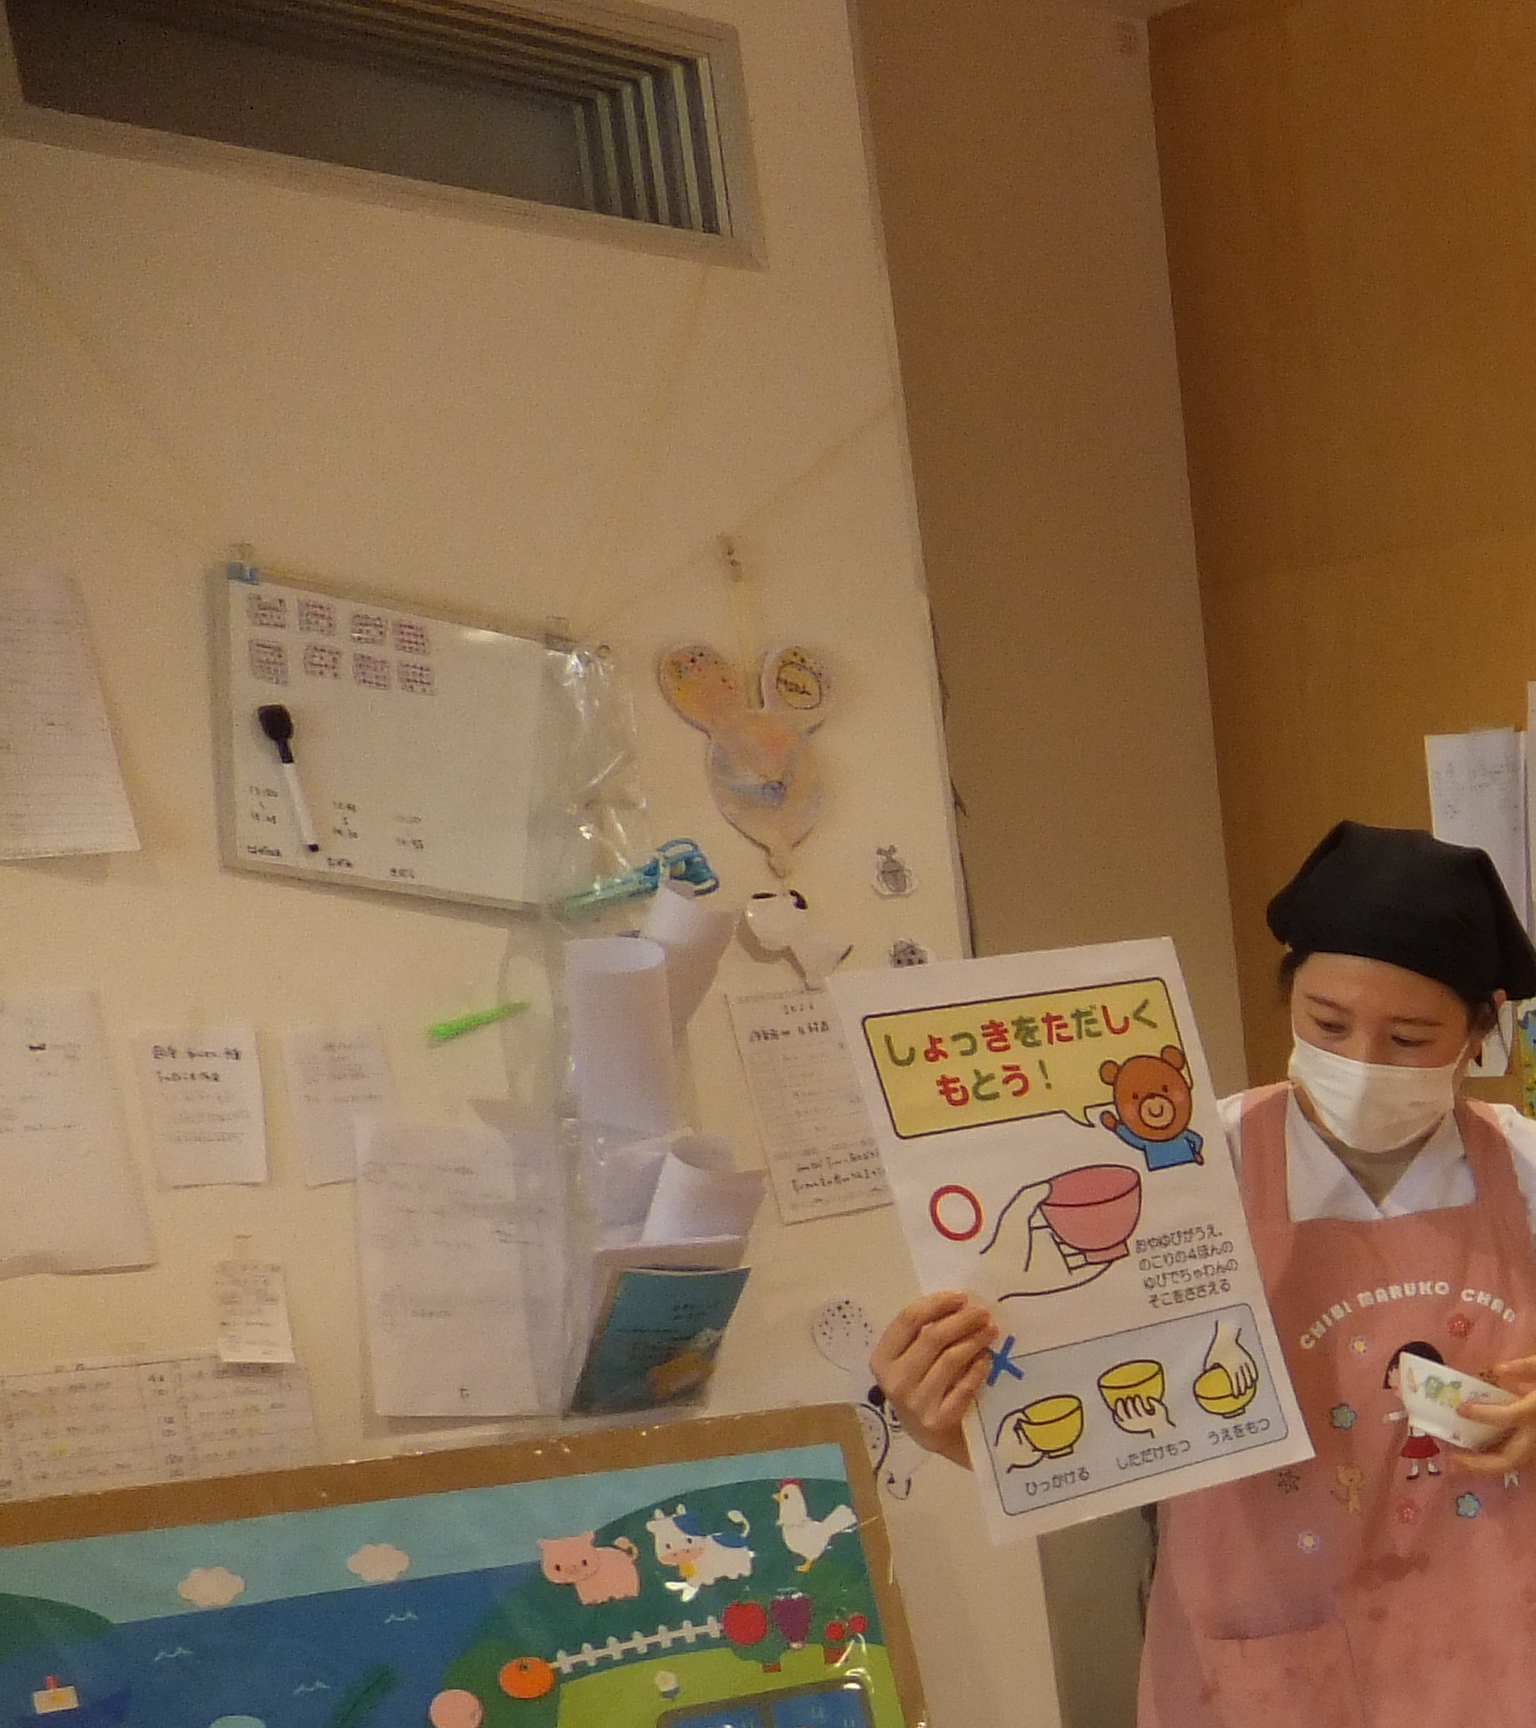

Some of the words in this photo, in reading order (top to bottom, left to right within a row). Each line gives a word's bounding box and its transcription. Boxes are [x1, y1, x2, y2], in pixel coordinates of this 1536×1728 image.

[884, 999, 1158, 1067] しょっきをただしく
[1357, 1281, 1451, 1308] MARUKO
[1207, 1417, 1271, 1446] うえをもつ
[1116, 1440, 1191, 1470] しただけもつ
[1025, 1467, 1090, 1497] ひっかける
